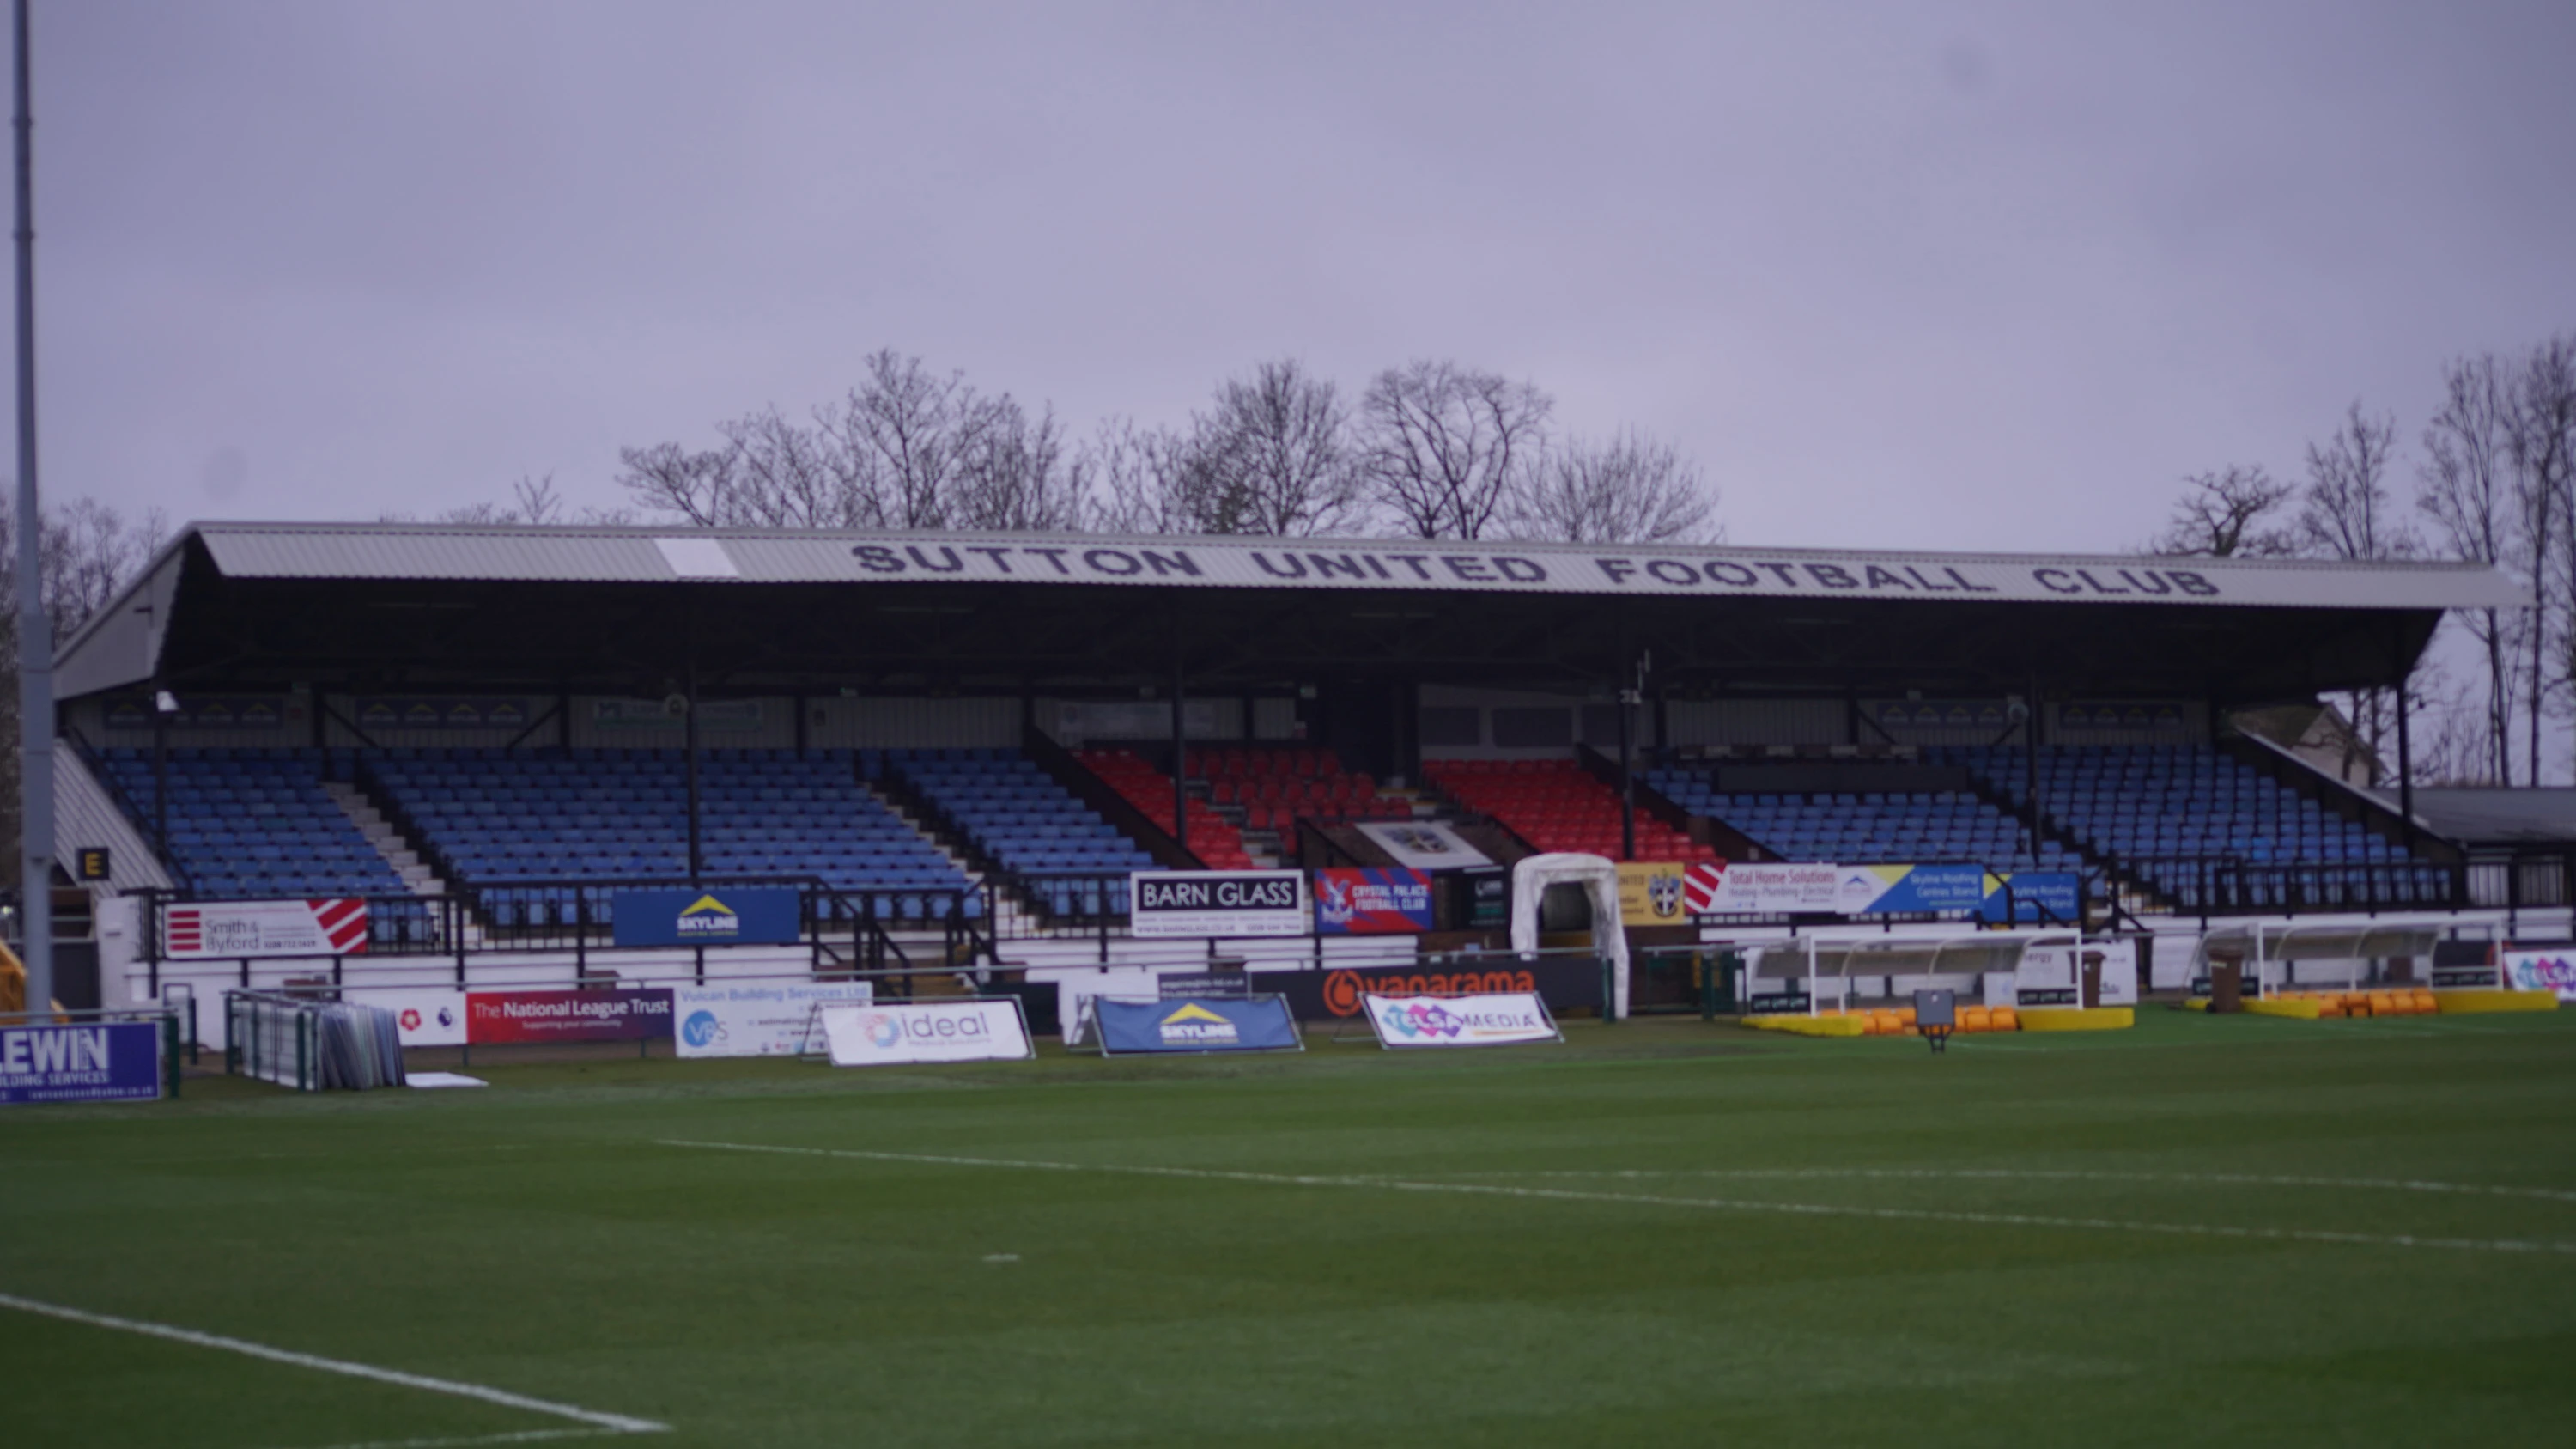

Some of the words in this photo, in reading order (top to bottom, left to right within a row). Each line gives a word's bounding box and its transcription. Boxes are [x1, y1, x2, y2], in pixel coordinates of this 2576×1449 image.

[851, 545, 1201, 576] SUTTON
[1250, 552, 1548, 582] UNITED
[1595, 558, 1998, 593] FOOTBALL
[2032, 569, 2221, 595] CLUB
[85, 853, 101, 875] E
[1619, 874, 1644, 887] NITED
[1728, 869, 1753, 885] Total
[1754, 869, 1786, 884] Home
[1789, 868, 1836, 883] Solutions
[1910, 873, 1941, 885] Skyline
[1943, 872, 1979, 884] Roofing
[1143, 884, 1210, 907] BARN
[1217, 882, 1292, 906] GLASS
[1352, 886, 1391, 898] CRYSTAL
[1394, 884, 1428, 898] PALACE
[1728, 886, 1757, 898] Heating
[1763, 886, 1799, 897] Plumbing
[1917, 886, 1950, 897] Centres
[1953, 885, 1979, 897] Stand
[2012, 886, 2038, 897] kyline
[2039, 884, 2074, 897] Roofing
[1354, 898, 1398, 911] FOOTBALL
[1401, 898, 1426, 910] CLUB
[2050, 898, 2074, 909] Stand
[206, 920, 247, 934] Smith
[252, 921, 259, 932] &
[677, 916, 738, 930] SKYLINE
[206, 935, 258, 952] Byford
[1367, 970, 1534, 999] vanarama
[680, 990, 725, 1002] Vulcan
[730, 989, 783, 1002] Building
[787, 988, 842, 999] Services
[847, 987, 867, 997] Ltd
[474, 1002, 501, 1017] The
[504, 1001, 570, 1017] National
[573, 999, 629, 1019] League
[631, 998, 670, 1014] Trust
[902, 1011, 990, 1038] ideal
[1462, 1013, 1537, 1027] MEDIA
[1160, 1024, 1237, 1038] SKYLINE
[0, 1029, 108, 1073] EWIN
[48, 1072, 110, 1085] SERVICES
